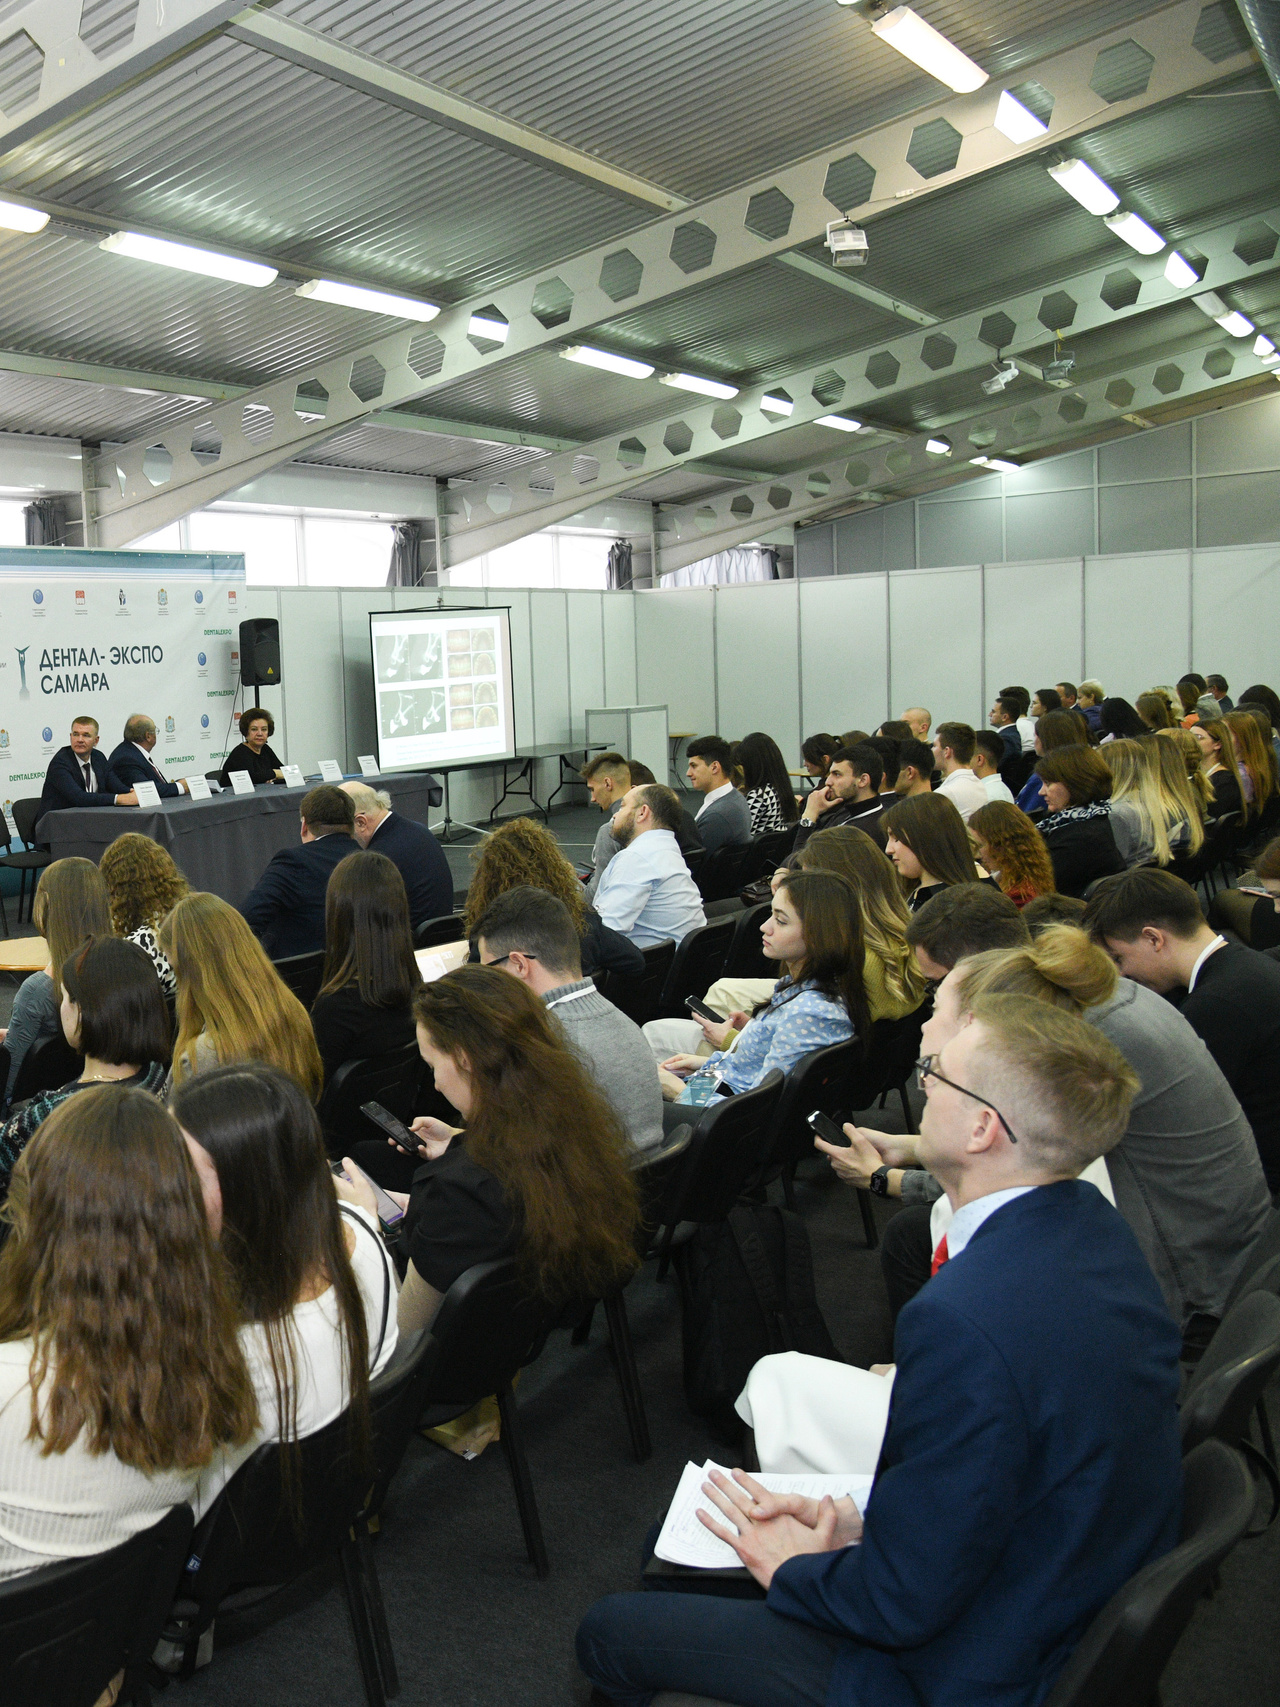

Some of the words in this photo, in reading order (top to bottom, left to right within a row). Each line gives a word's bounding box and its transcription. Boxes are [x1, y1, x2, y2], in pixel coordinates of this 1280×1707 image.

[39, 648, 106, 671] ДЕНТАЛ-
[109, 645, 164, 665] ЭКСПО
[41, 672, 110, 694] САМАРА
[9, 772, 46, 782] DENTALEXPO
